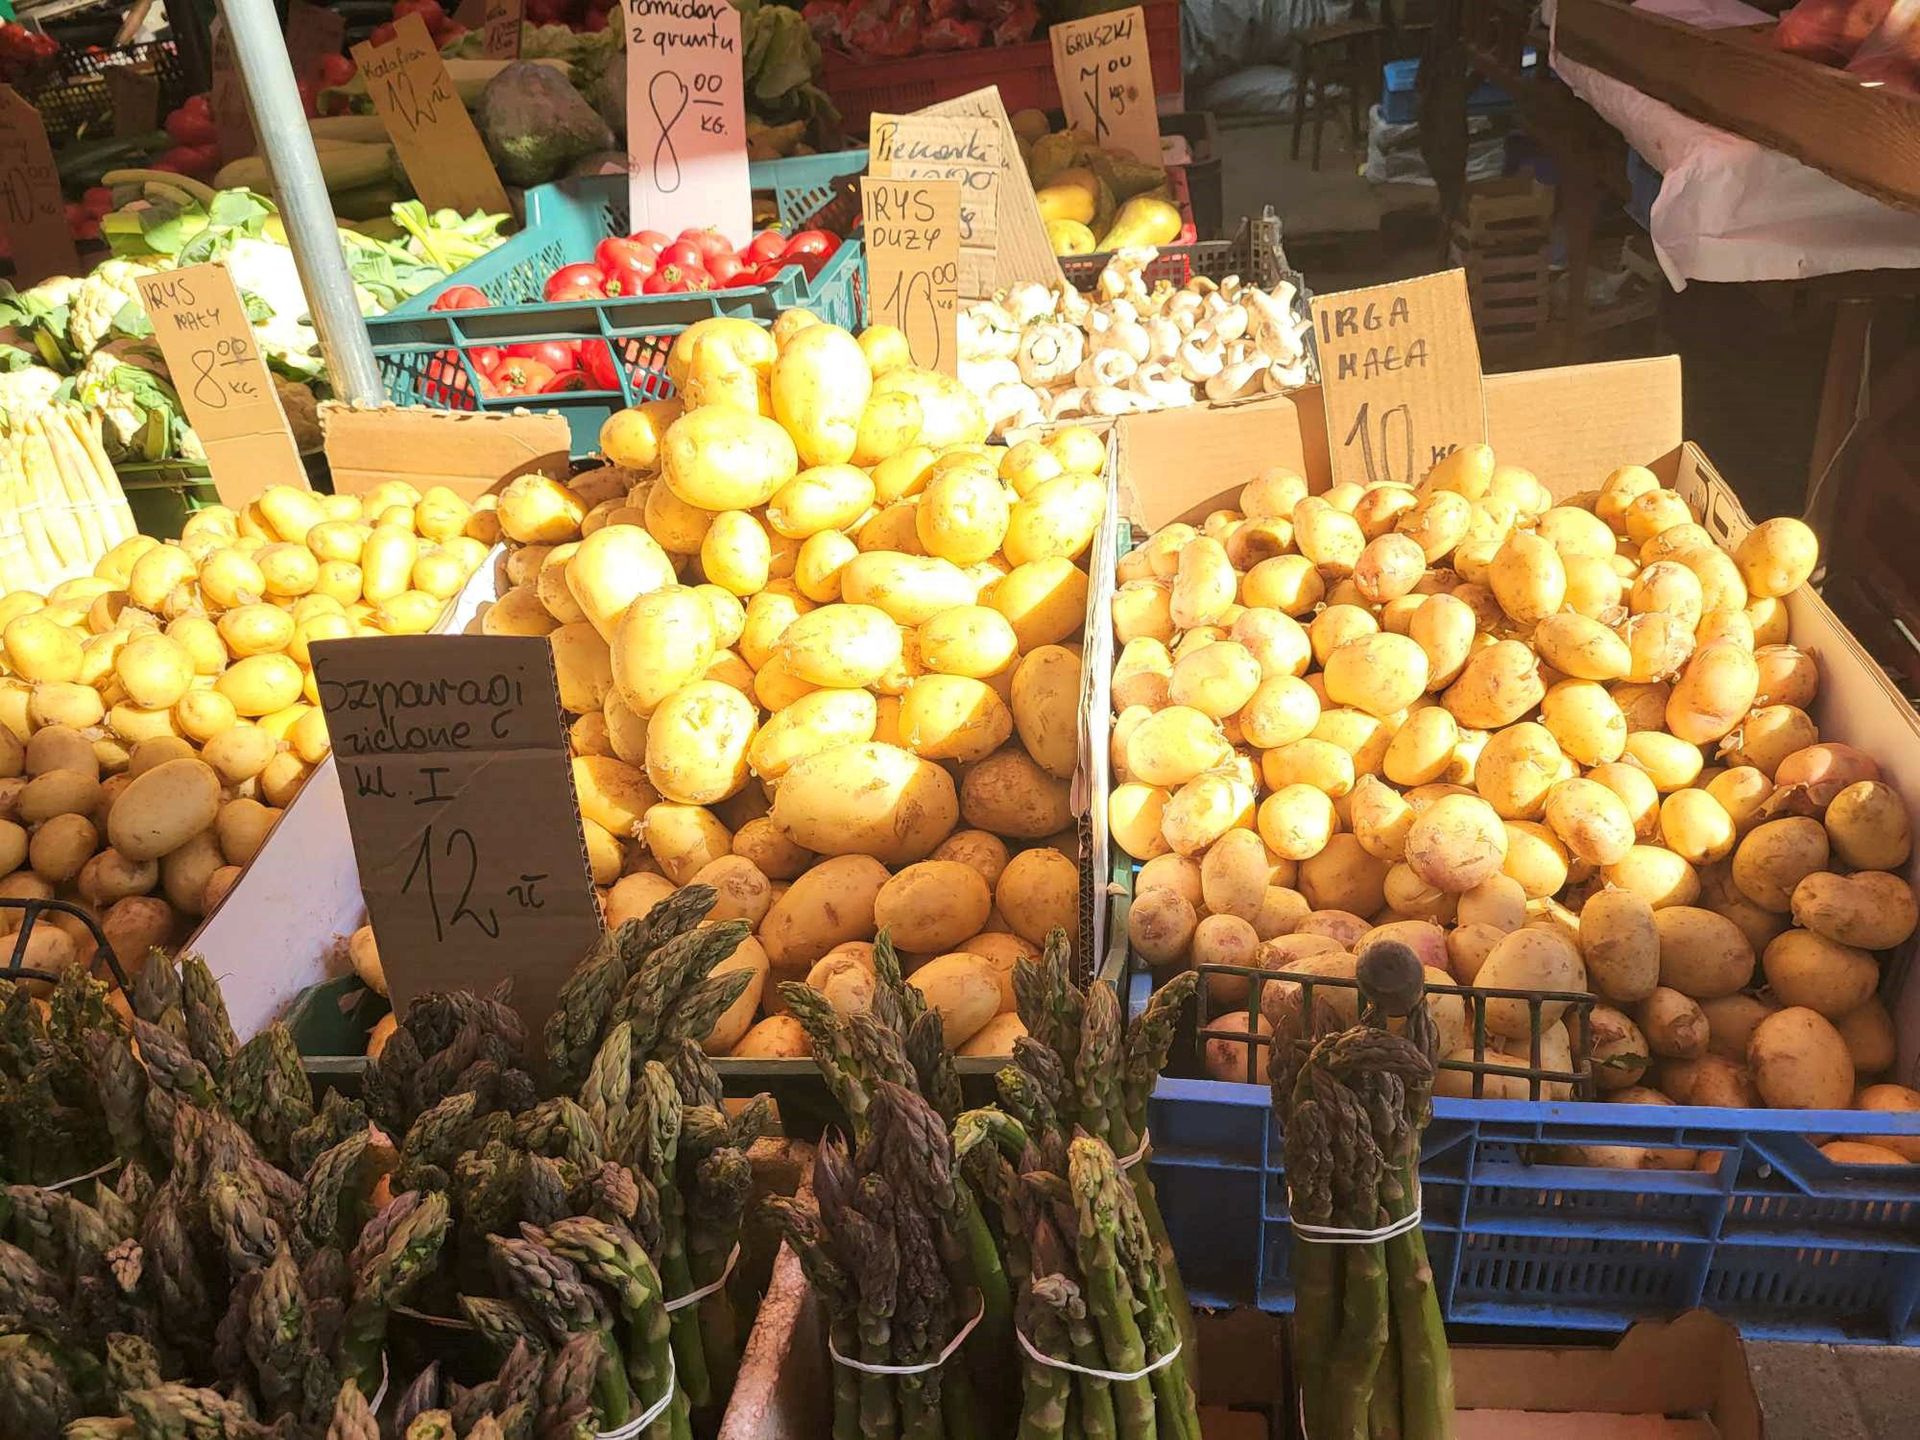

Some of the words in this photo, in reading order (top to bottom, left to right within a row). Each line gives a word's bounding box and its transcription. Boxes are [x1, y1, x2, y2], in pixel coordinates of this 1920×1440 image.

[653, 22, 733, 56] gruntu
[1066, 14, 1135, 55] GRUSZKI
[649, 70, 688, 193] 8
[694, 73, 722, 92] 00
[867, 186, 935, 222] IRYS
[143, 278, 195, 311] IRYS
[884, 270, 940, 371] 10
[932, 262, 957, 285] 00
[1321, 297, 1409, 343] IRGA
[192, 349, 227, 409] 8
[217, 337, 247, 356] 00
[1344, 403, 1414, 482] 10
[402, 825, 500, 942] 12
